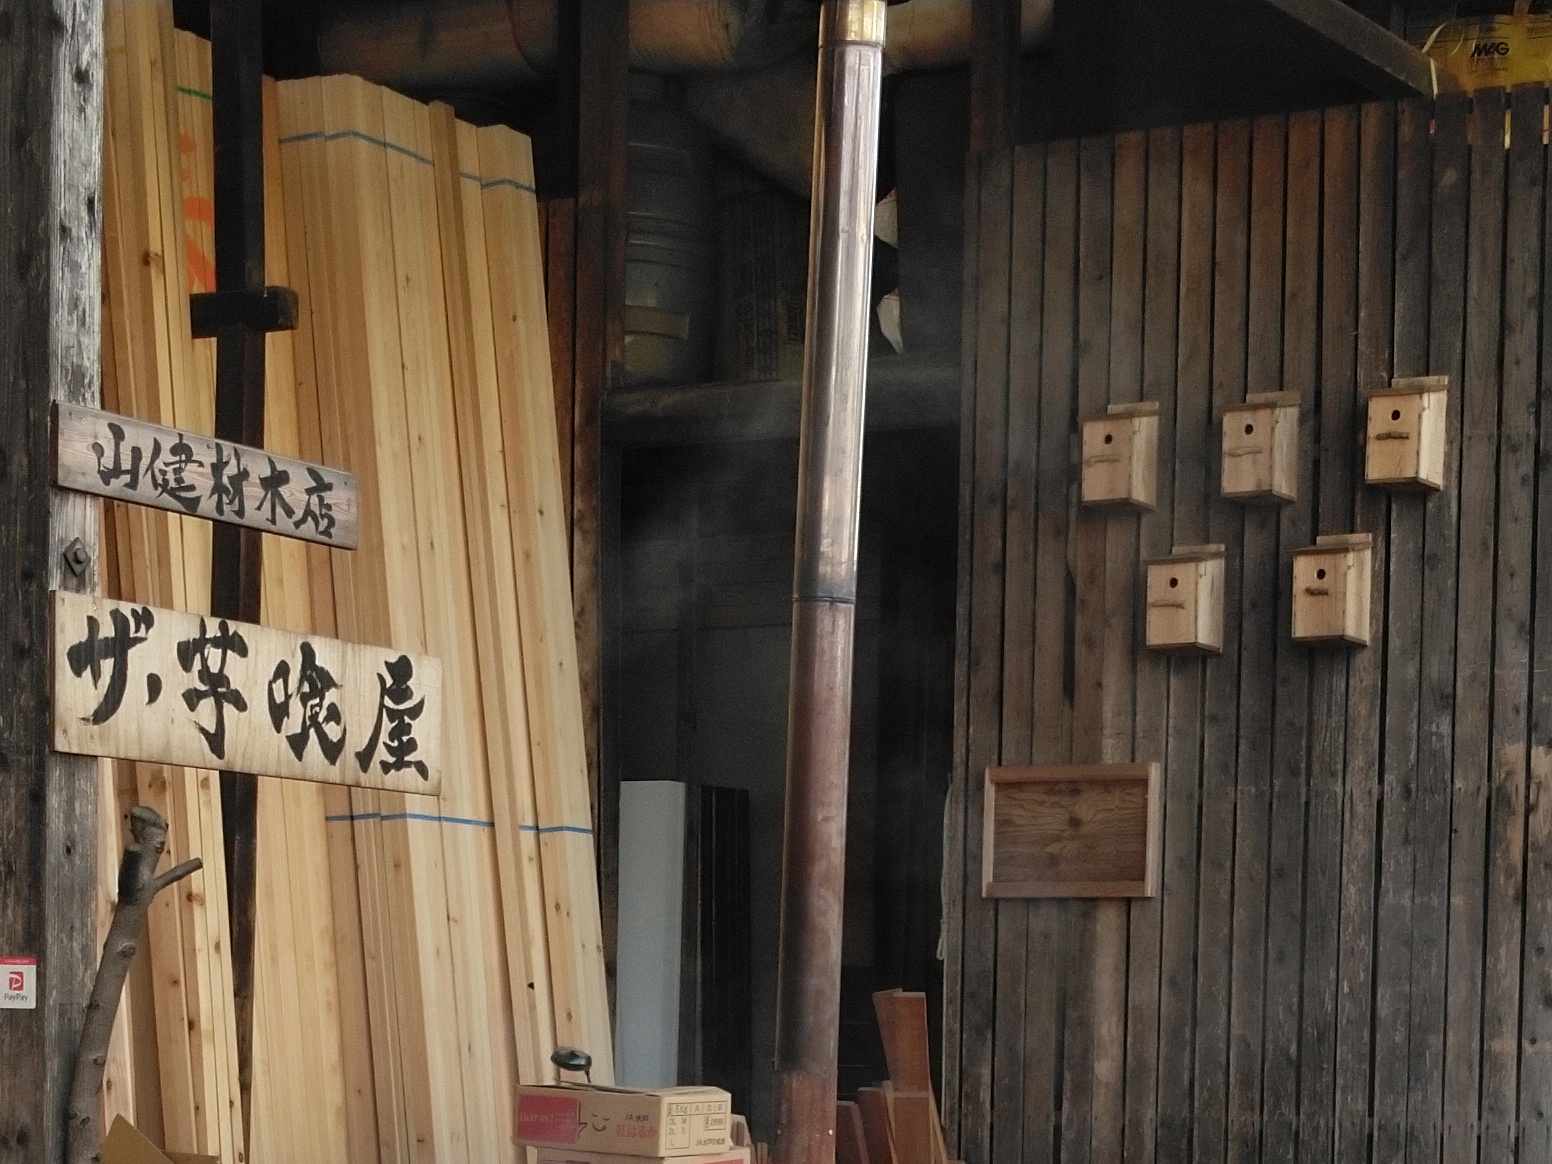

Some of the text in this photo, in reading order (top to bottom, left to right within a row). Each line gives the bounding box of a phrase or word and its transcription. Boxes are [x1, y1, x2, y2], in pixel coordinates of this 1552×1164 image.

[93, 421, 335, 540] 山健材木店
[4, 993, 28, 1001] PayPay
